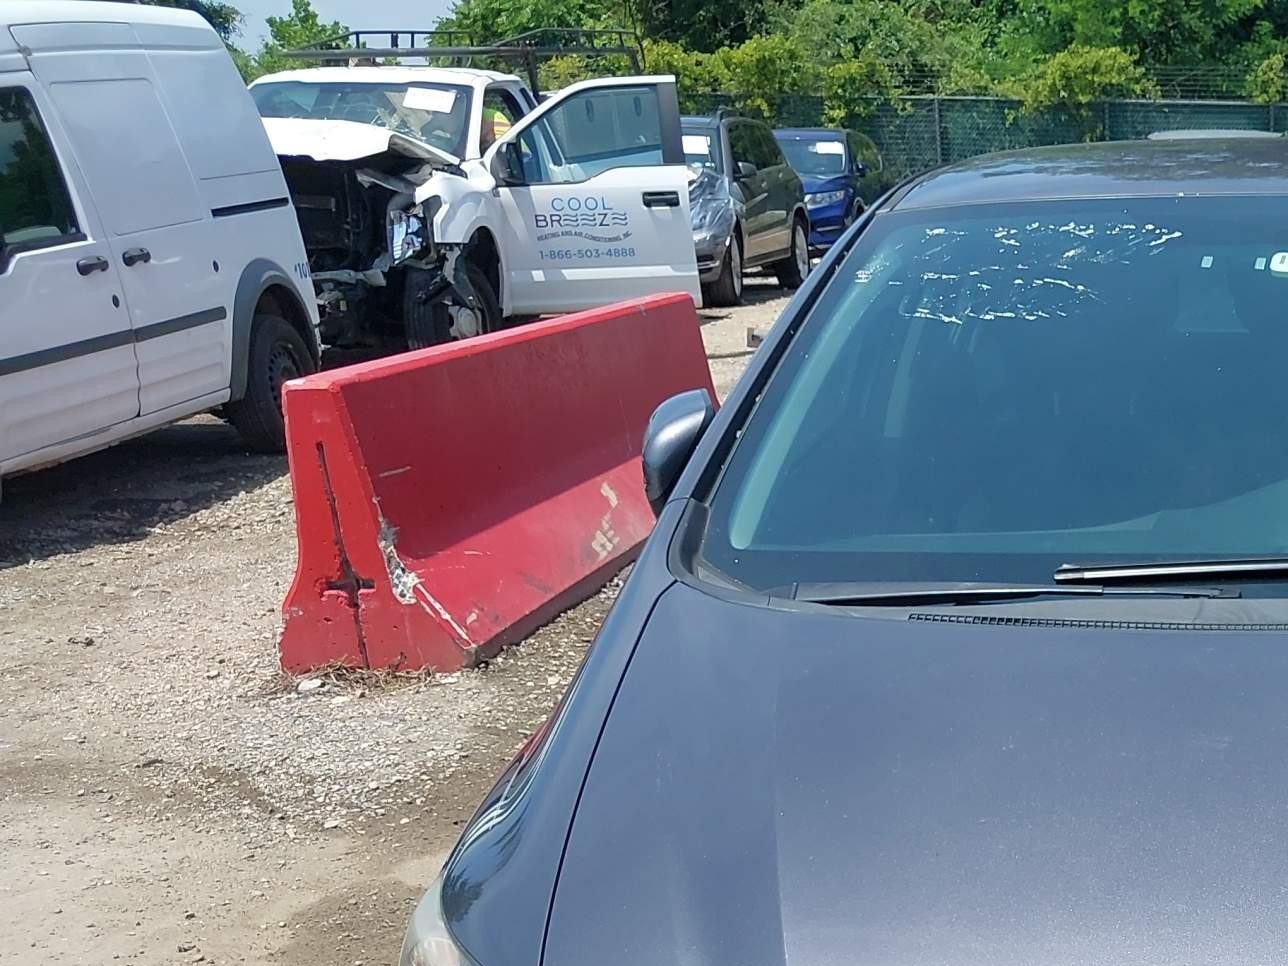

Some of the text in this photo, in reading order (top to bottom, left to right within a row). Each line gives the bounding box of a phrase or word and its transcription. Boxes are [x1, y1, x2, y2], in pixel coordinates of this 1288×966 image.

[551, 196, 613, 211] COOL
[534, 212, 628, 228] BREEZE
[539, 248, 636, 260] 1-866-503-4888
